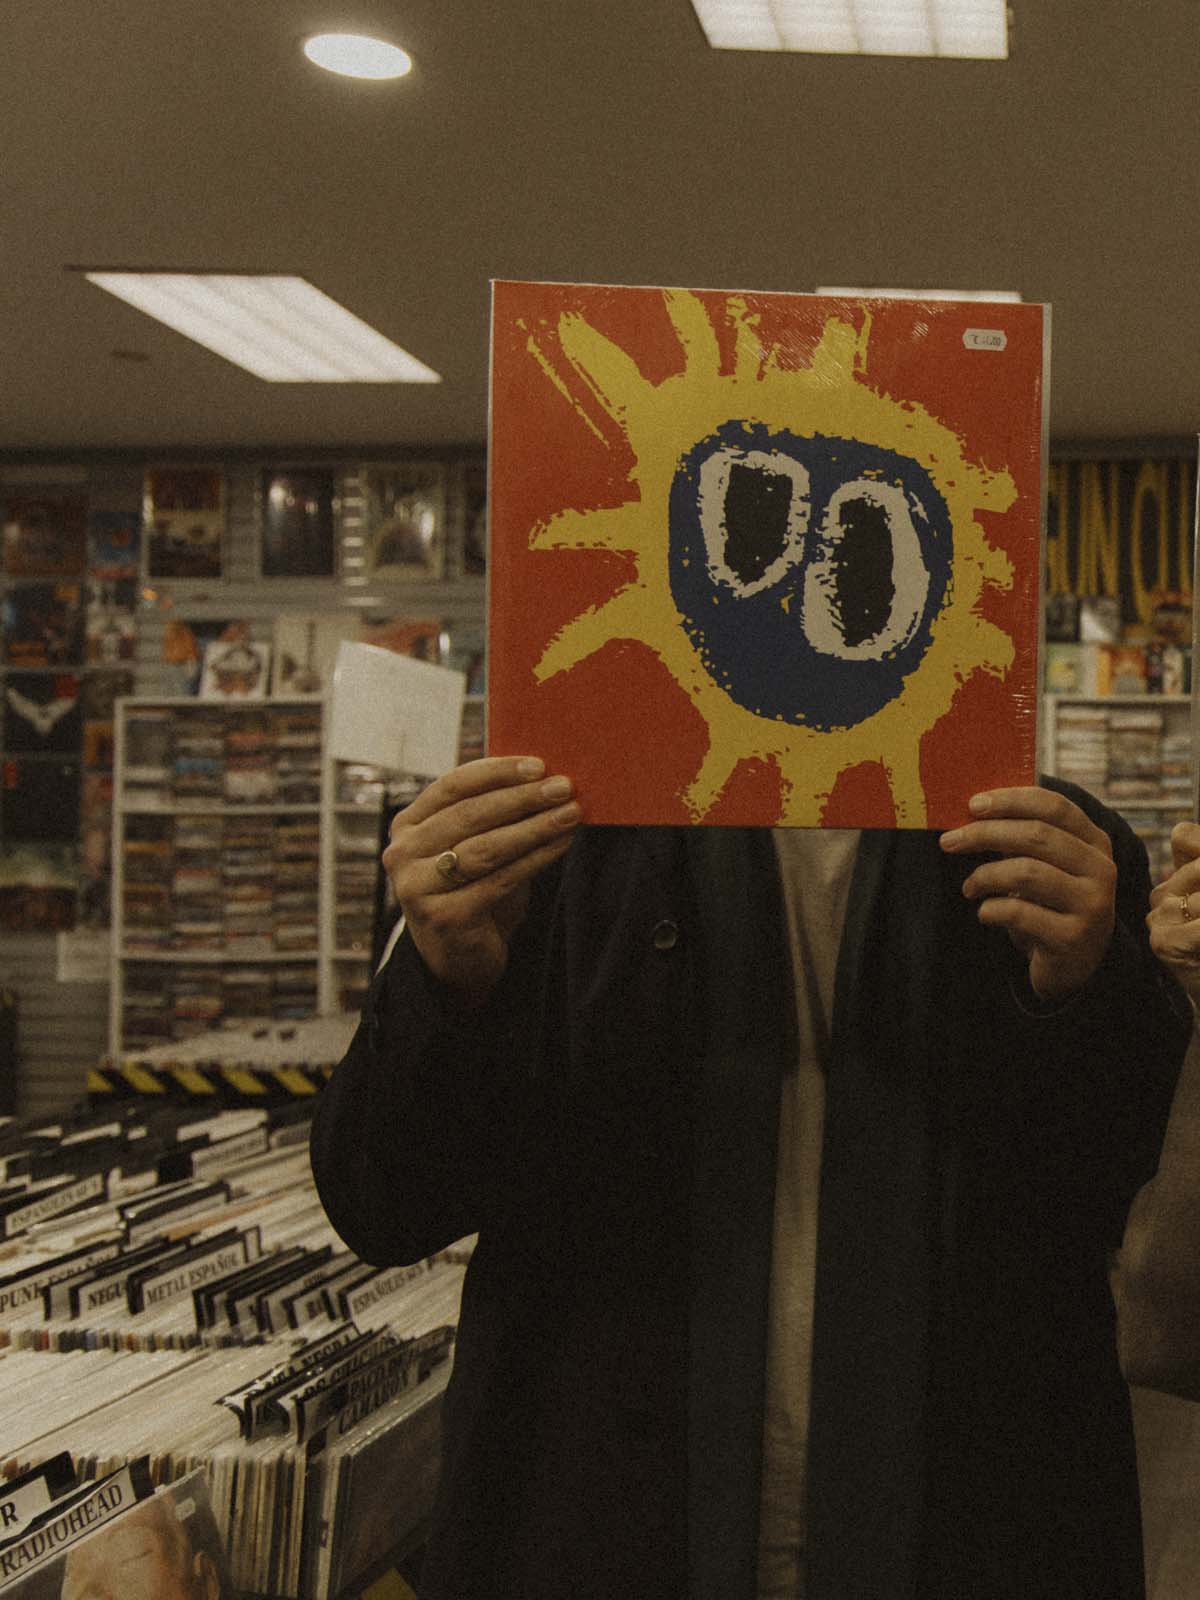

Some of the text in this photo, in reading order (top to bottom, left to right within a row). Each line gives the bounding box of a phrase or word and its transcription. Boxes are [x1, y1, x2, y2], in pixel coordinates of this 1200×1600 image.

[147, 1275, 188, 1304] METAL
[0, 1501, 19, 1527] R
[1, 1484, 124, 1577] RADIOHEAD
